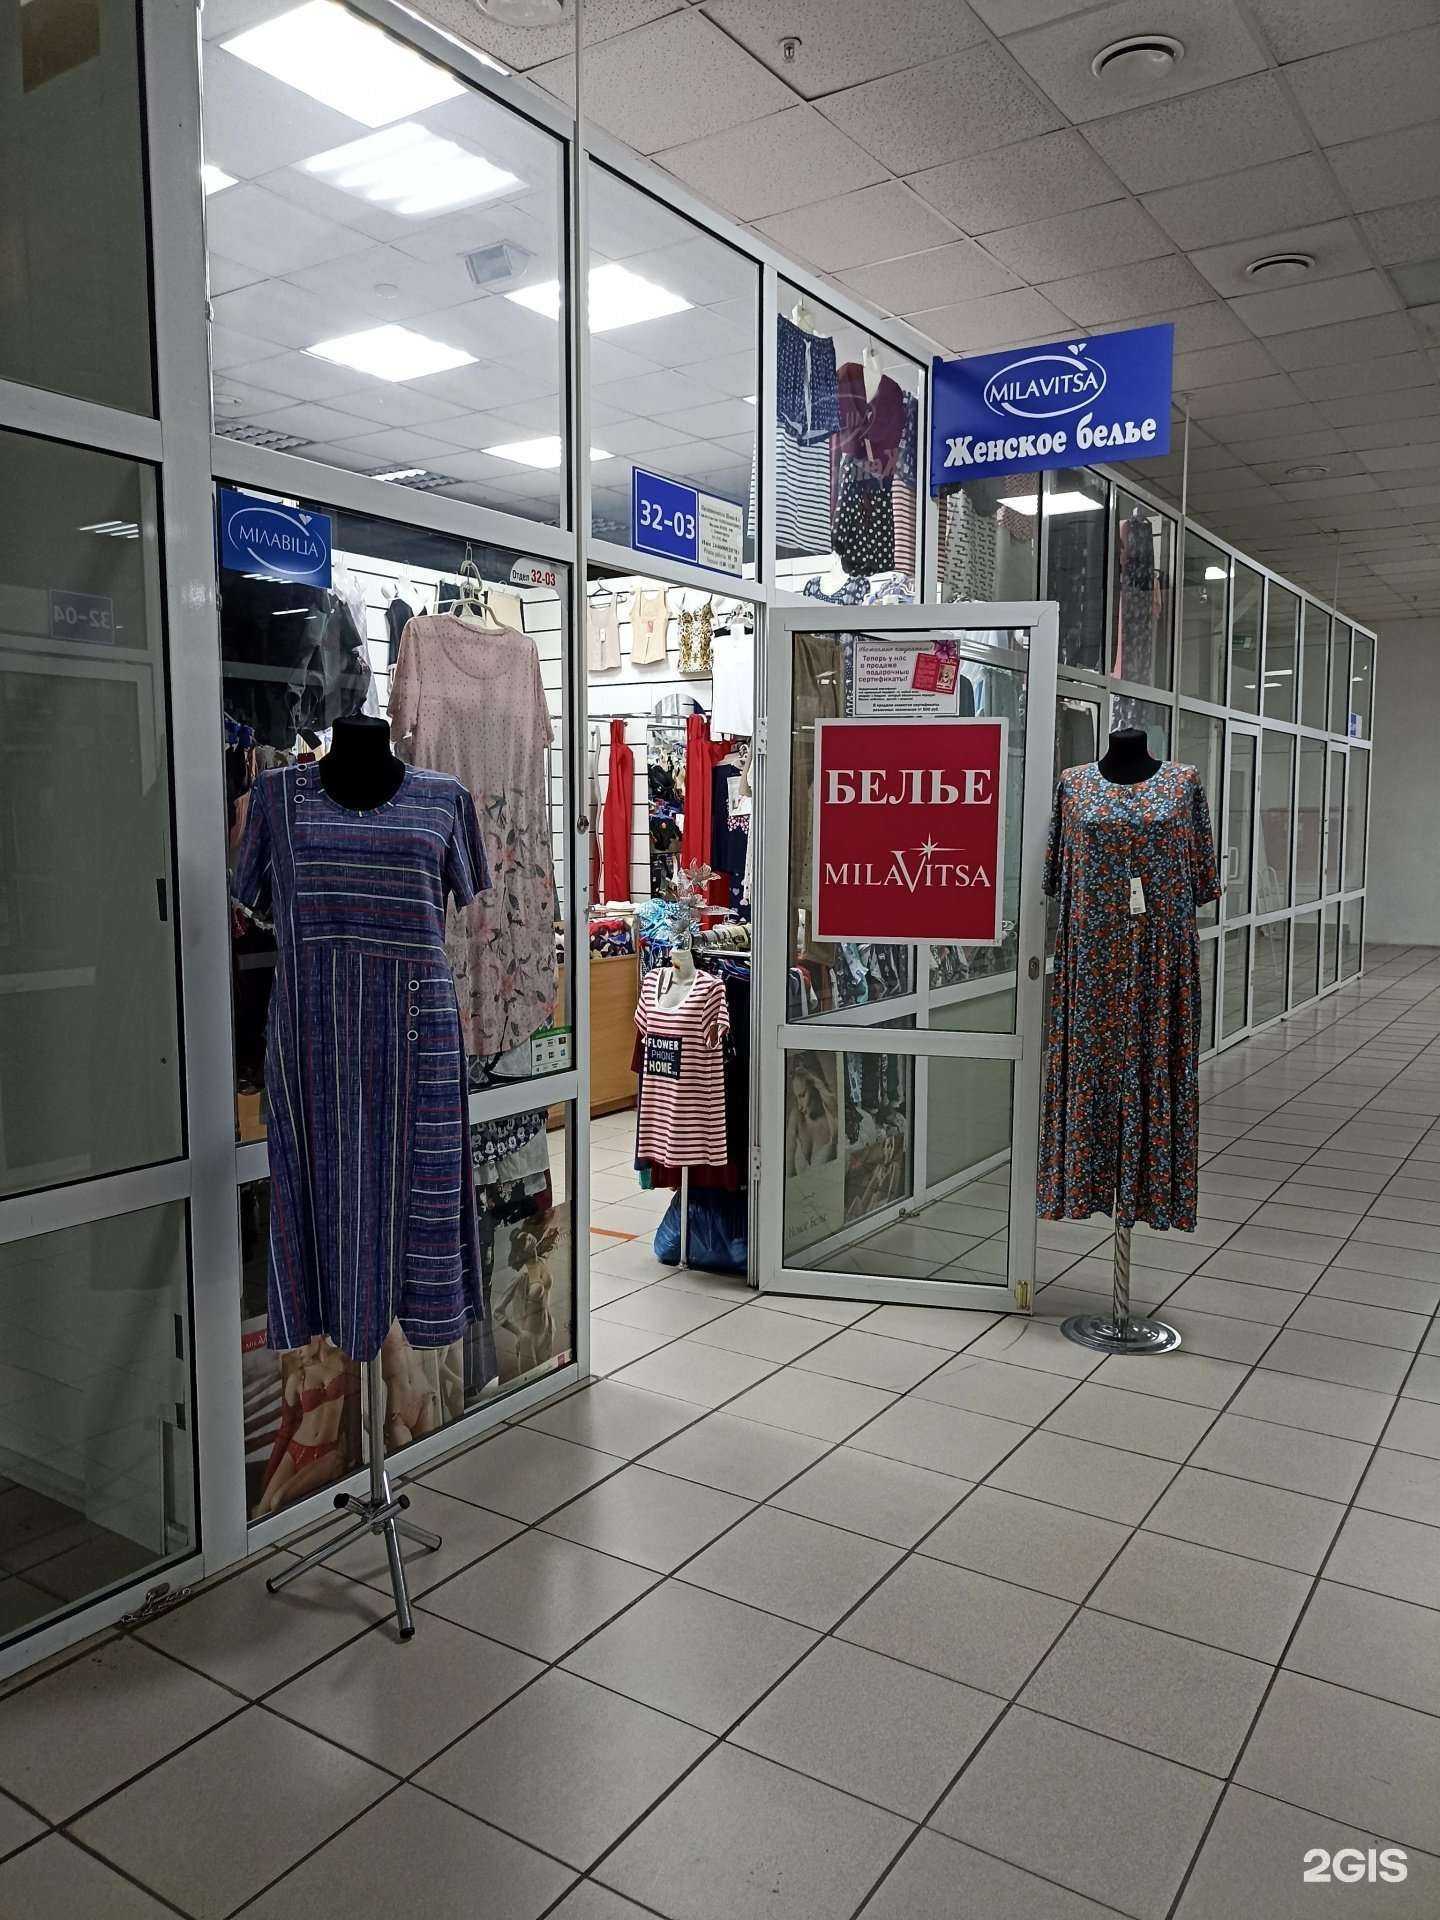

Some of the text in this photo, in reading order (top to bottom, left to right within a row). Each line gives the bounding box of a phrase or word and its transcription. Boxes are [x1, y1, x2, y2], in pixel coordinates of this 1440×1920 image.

[989, 371, 1099, 403] MILAVITSA
[943, 429, 1067, 468] Женское
[1076, 412, 1157, 450] белье
[640, 499, 695, 540] 32-03
[512, 568, 556, 586] Отдел 32-03
[824, 768, 993, 805] БЕЛЬЕ
[824, 849, 992, 894] MILAVITSA
[647, 1037, 679, 1051] FLOWER
[651, 1049, 675, 1062] PHONE
[649, 1060, 673, 1075] HOME
